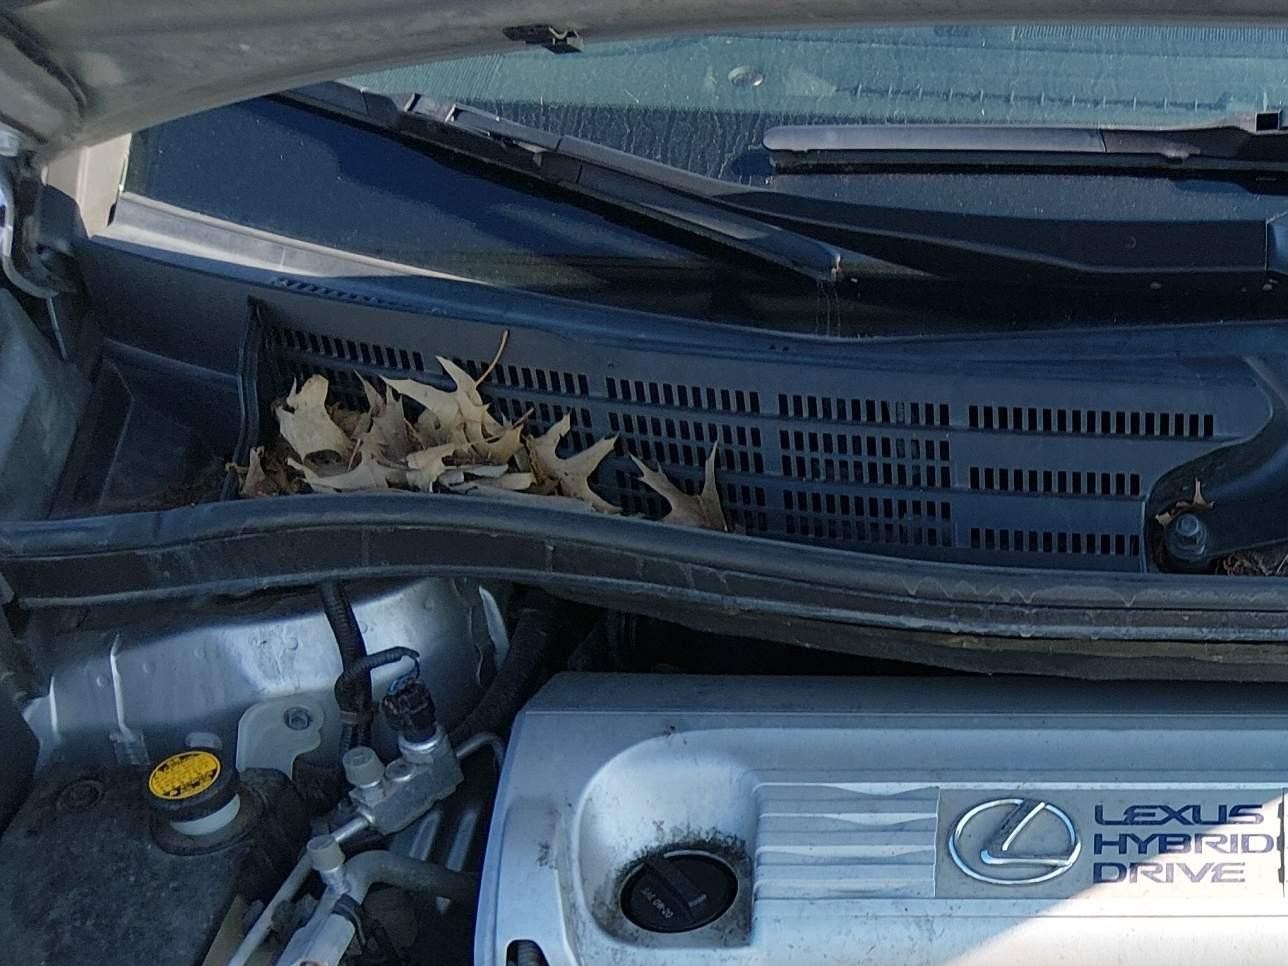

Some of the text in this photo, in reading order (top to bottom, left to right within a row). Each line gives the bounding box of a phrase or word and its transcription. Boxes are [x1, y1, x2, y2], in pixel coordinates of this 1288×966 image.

[1094, 804, 1265, 826] LEXUS
[1093, 833, 1275, 855] HYBRID
[1092, 862, 1246, 884] DRIVE
